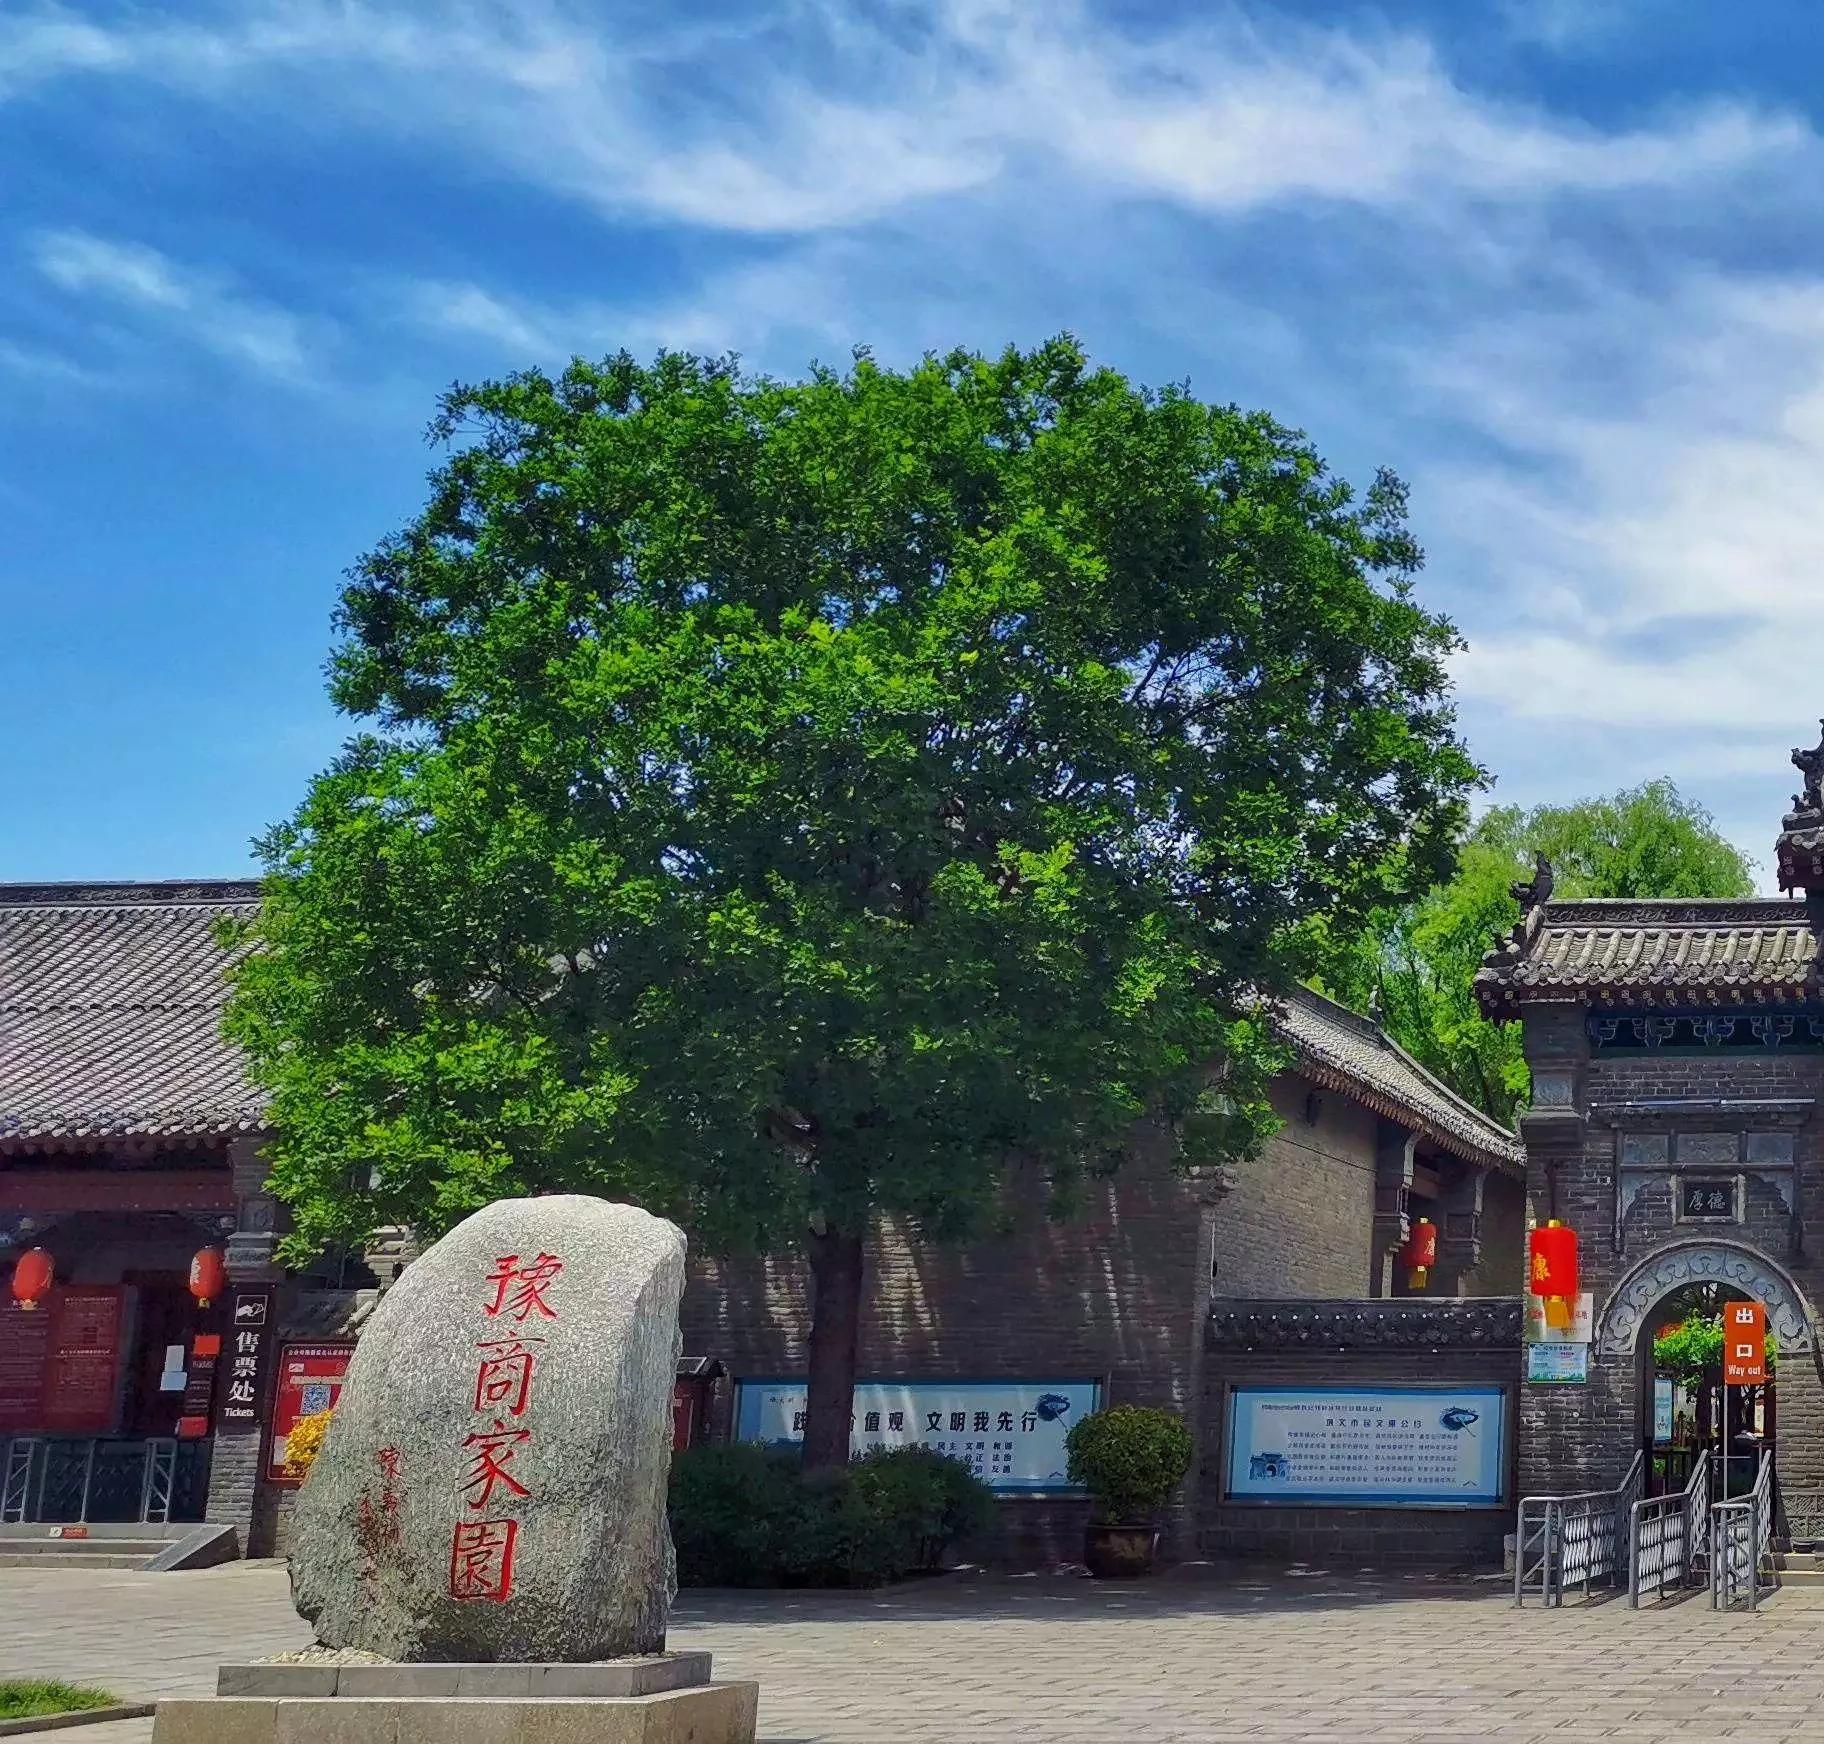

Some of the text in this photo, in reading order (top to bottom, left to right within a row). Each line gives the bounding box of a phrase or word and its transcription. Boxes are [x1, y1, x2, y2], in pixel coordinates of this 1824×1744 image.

[1736, 1308, 1754, 1357] 出口
[229, 1331, 261, 1402] 售票处
[1728, 1364, 1761, 1376] Way out
[224, 1408, 255, 1417] Tickets
[925, 1411, 1038, 1433] 文明我先行
